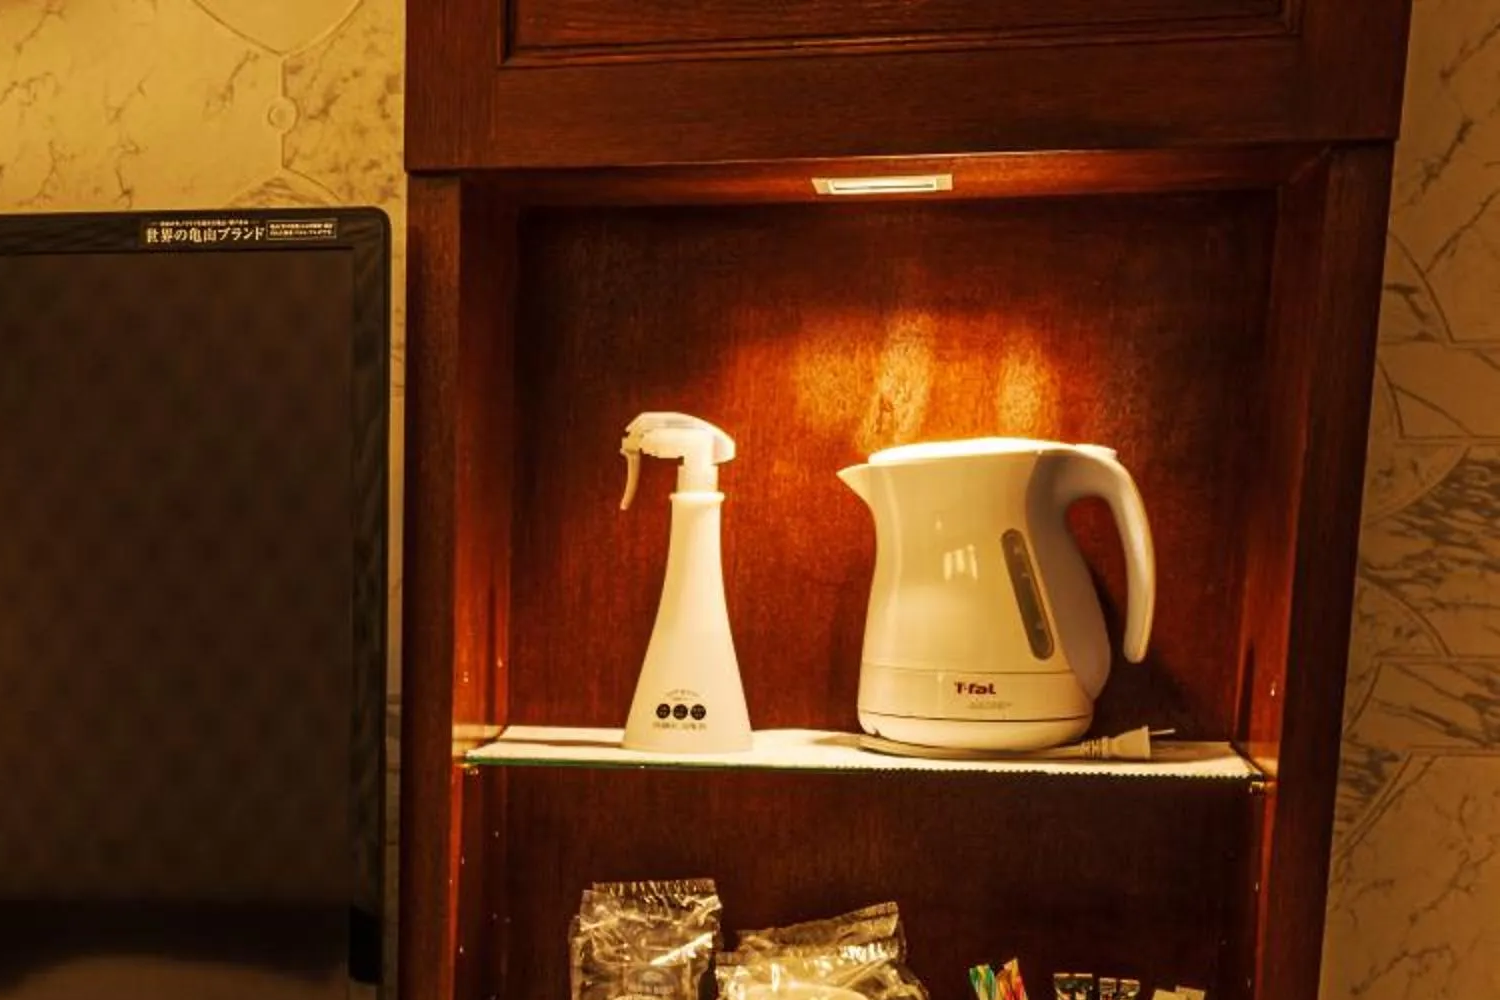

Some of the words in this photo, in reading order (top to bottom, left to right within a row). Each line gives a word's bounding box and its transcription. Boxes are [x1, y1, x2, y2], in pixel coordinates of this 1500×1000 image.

[146, 226, 264, 243] 世界の亀山ブランド
